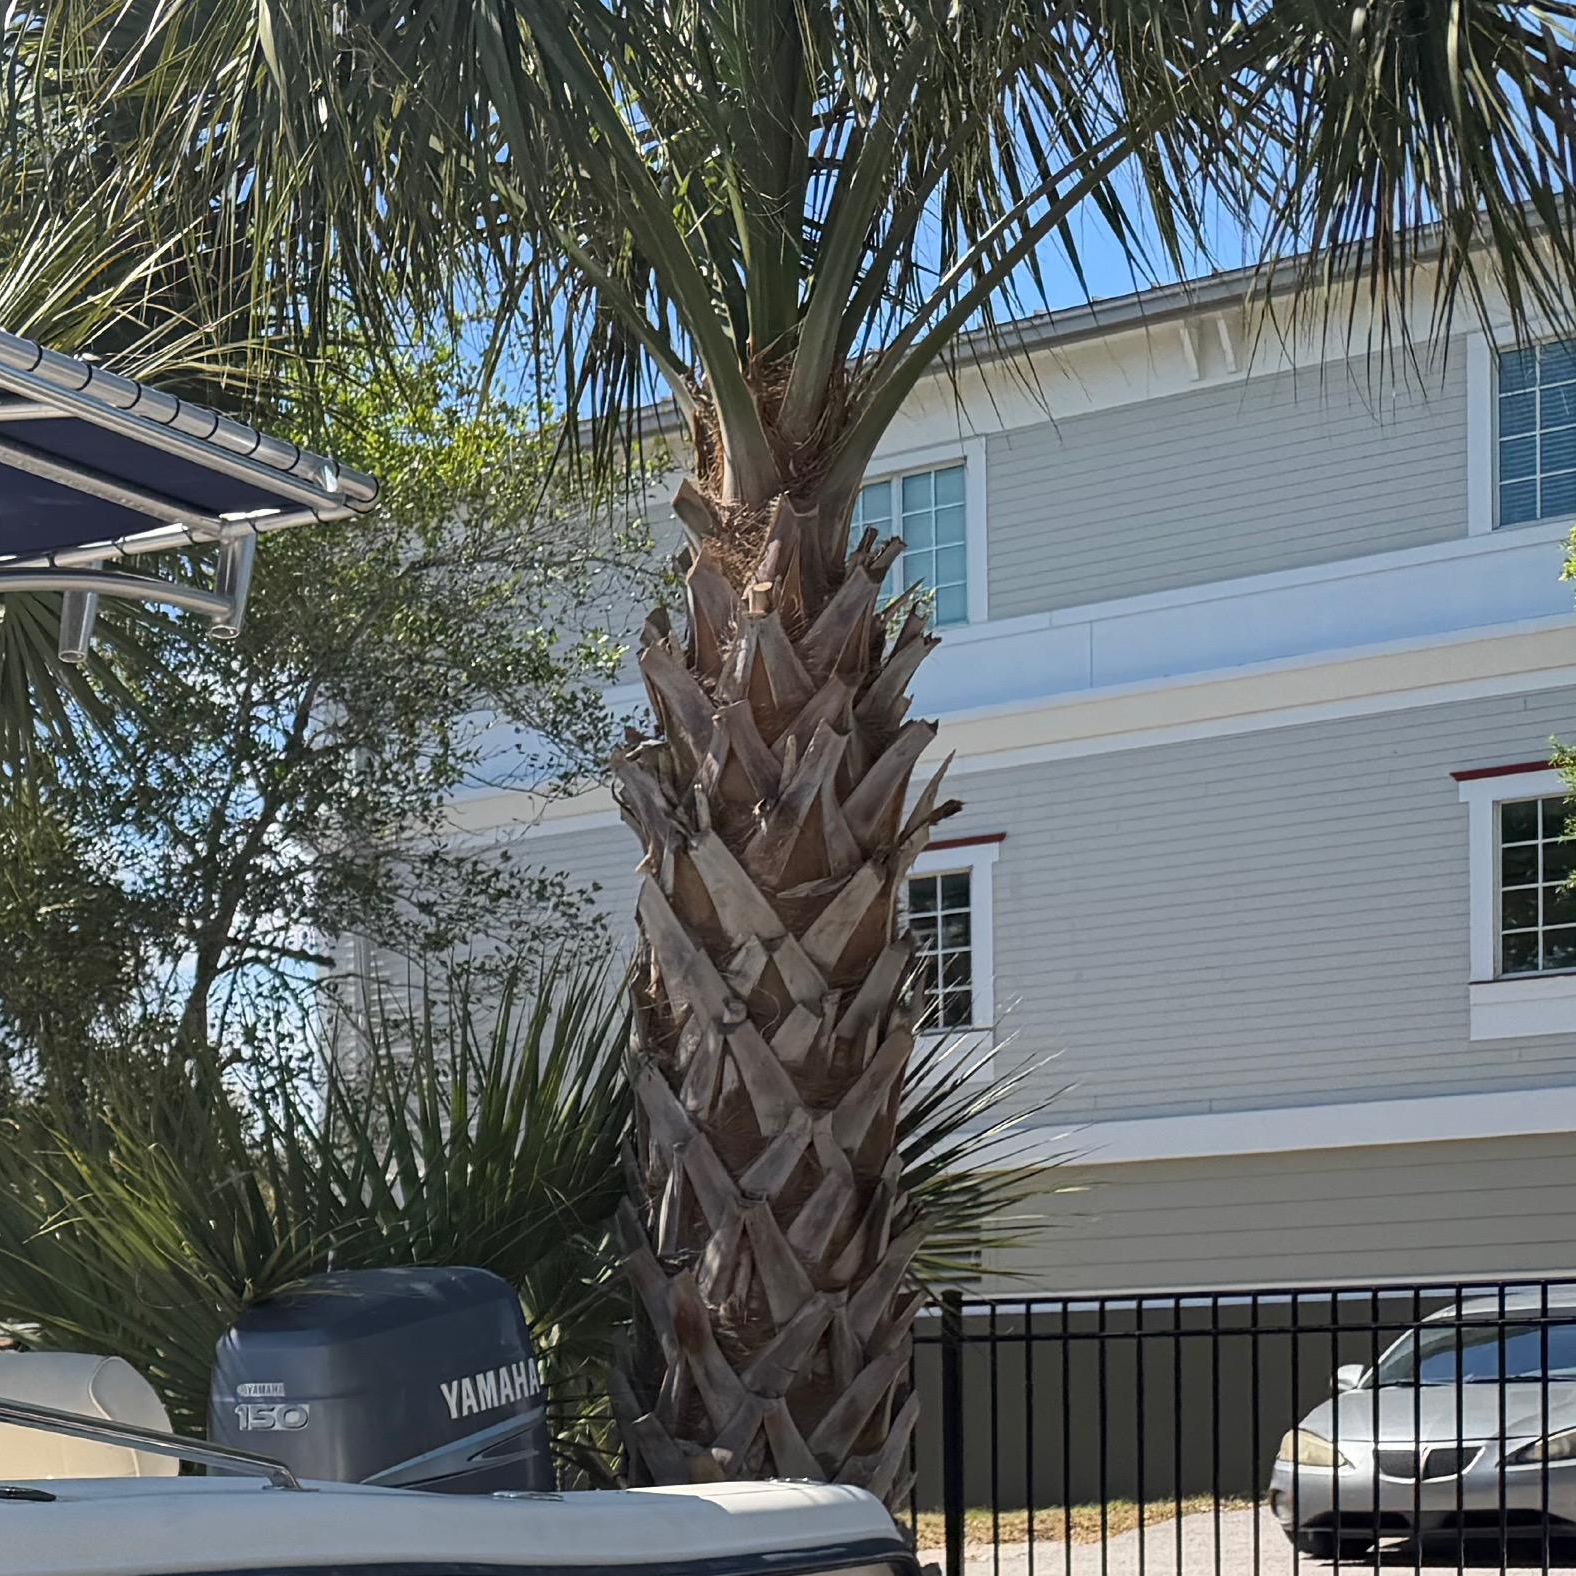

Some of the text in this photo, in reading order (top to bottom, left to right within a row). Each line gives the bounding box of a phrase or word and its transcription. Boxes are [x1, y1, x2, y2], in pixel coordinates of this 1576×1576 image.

[247, 1383, 285, 1397] YAMAHA
[439, 1358, 540, 1420] YAMAHA
[235, 1404, 310, 1431] 150
